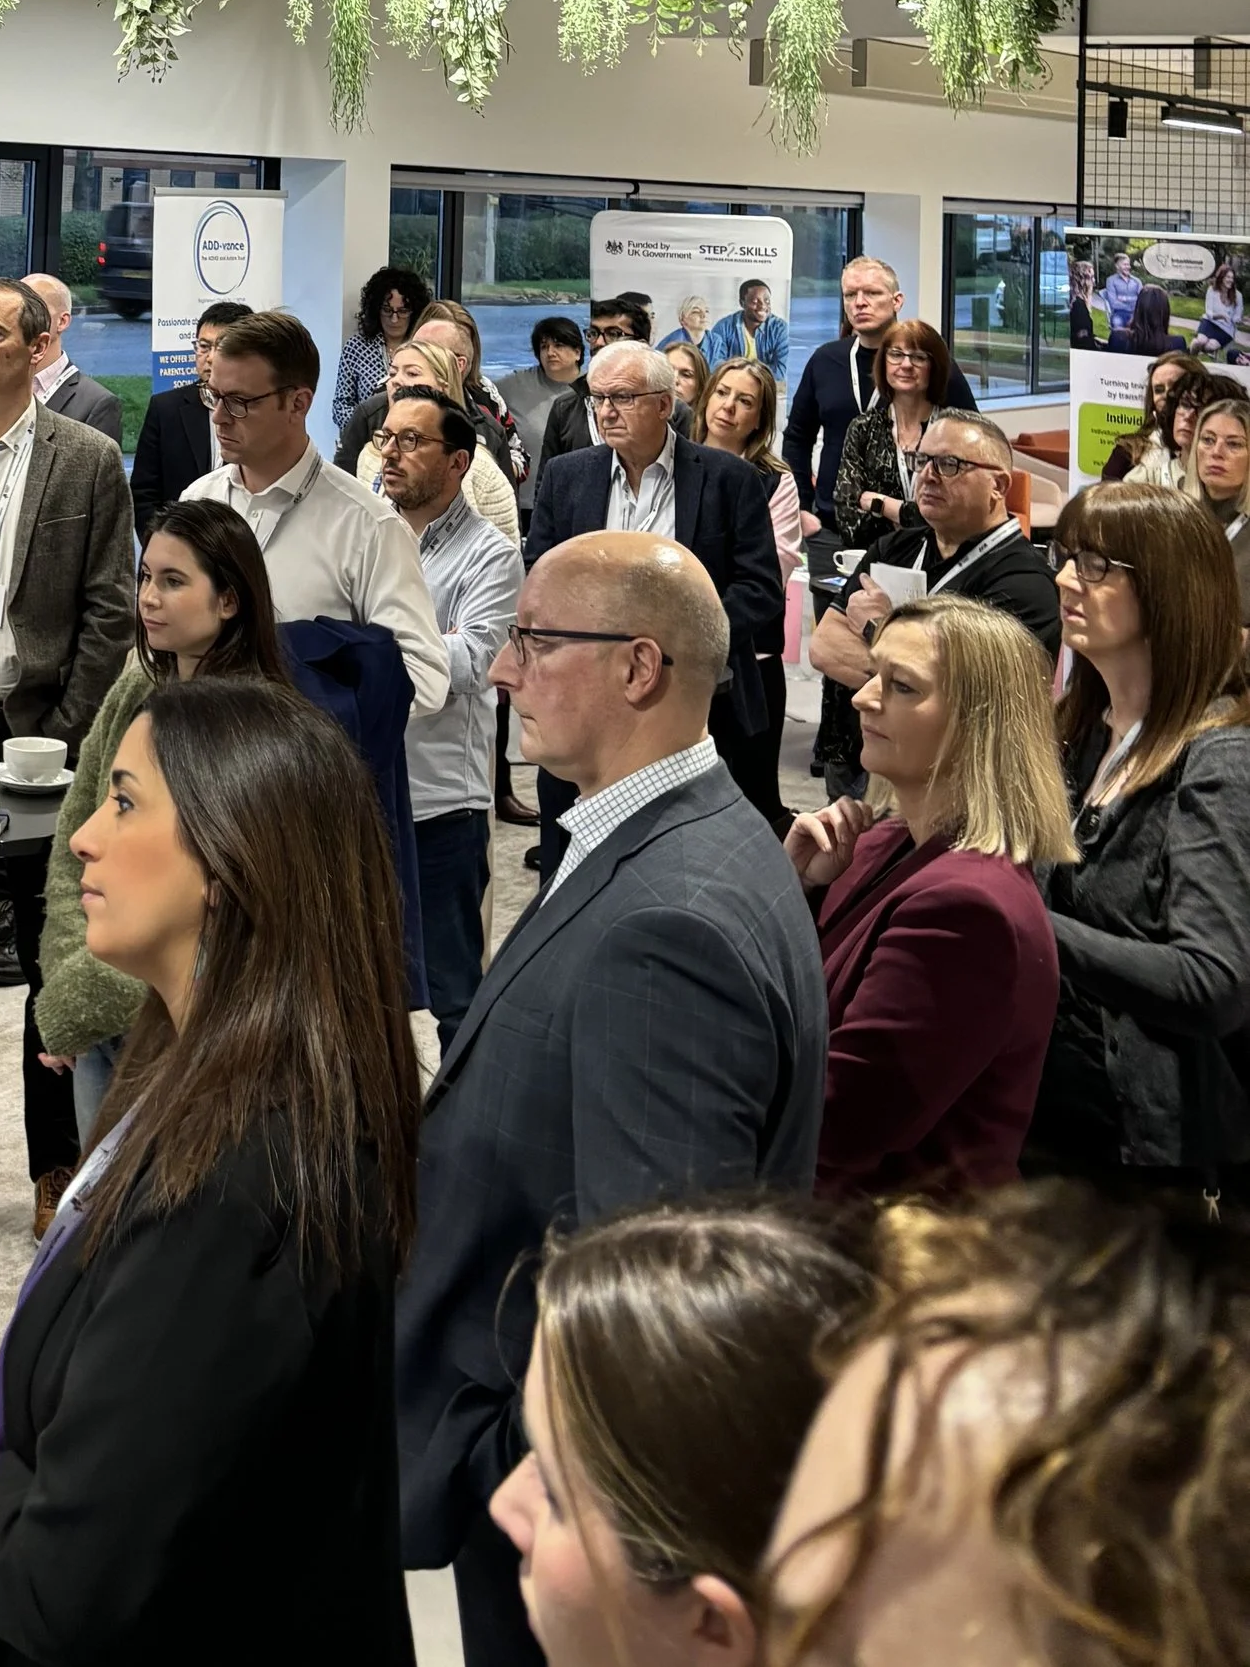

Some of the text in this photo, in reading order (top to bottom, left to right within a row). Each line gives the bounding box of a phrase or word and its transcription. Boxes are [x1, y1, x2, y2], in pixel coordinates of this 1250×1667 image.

[627, 240, 671, 251] Funded by
[627, 249, 692, 259] UK Government
[158, 318, 191, 326] Passionate
[1100, 378, 1129, 390] Turning
